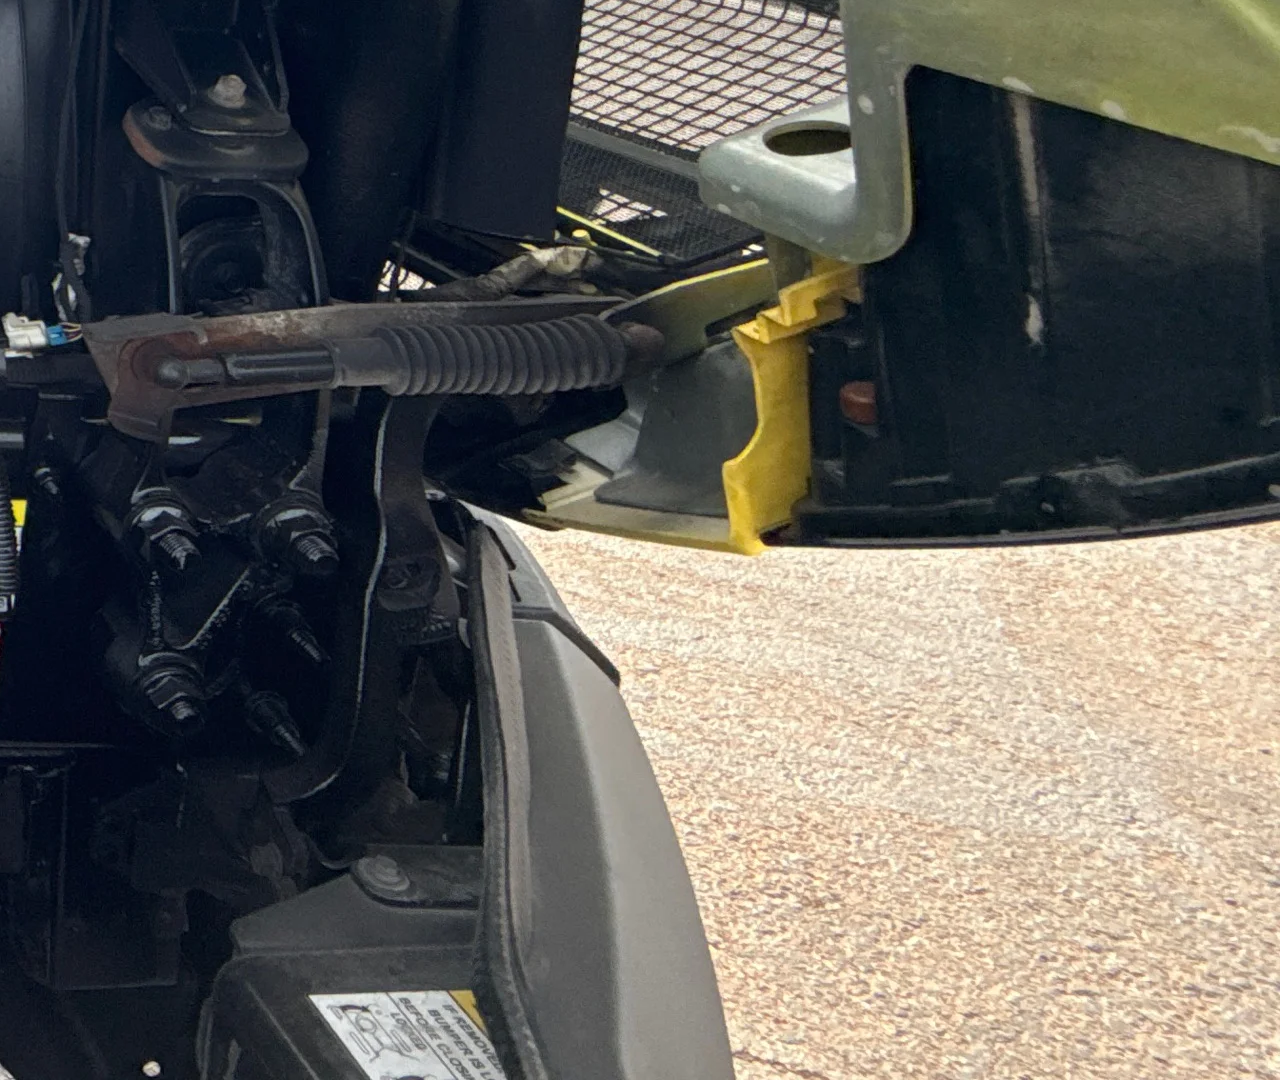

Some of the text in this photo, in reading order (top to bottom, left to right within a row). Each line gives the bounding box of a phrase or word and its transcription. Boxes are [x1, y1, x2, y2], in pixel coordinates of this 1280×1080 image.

[399, 997, 442, 1041] BEFORE
[442, 1004, 458, 1015] IF
[428, 1009, 486, 1070] BUMPER IS
